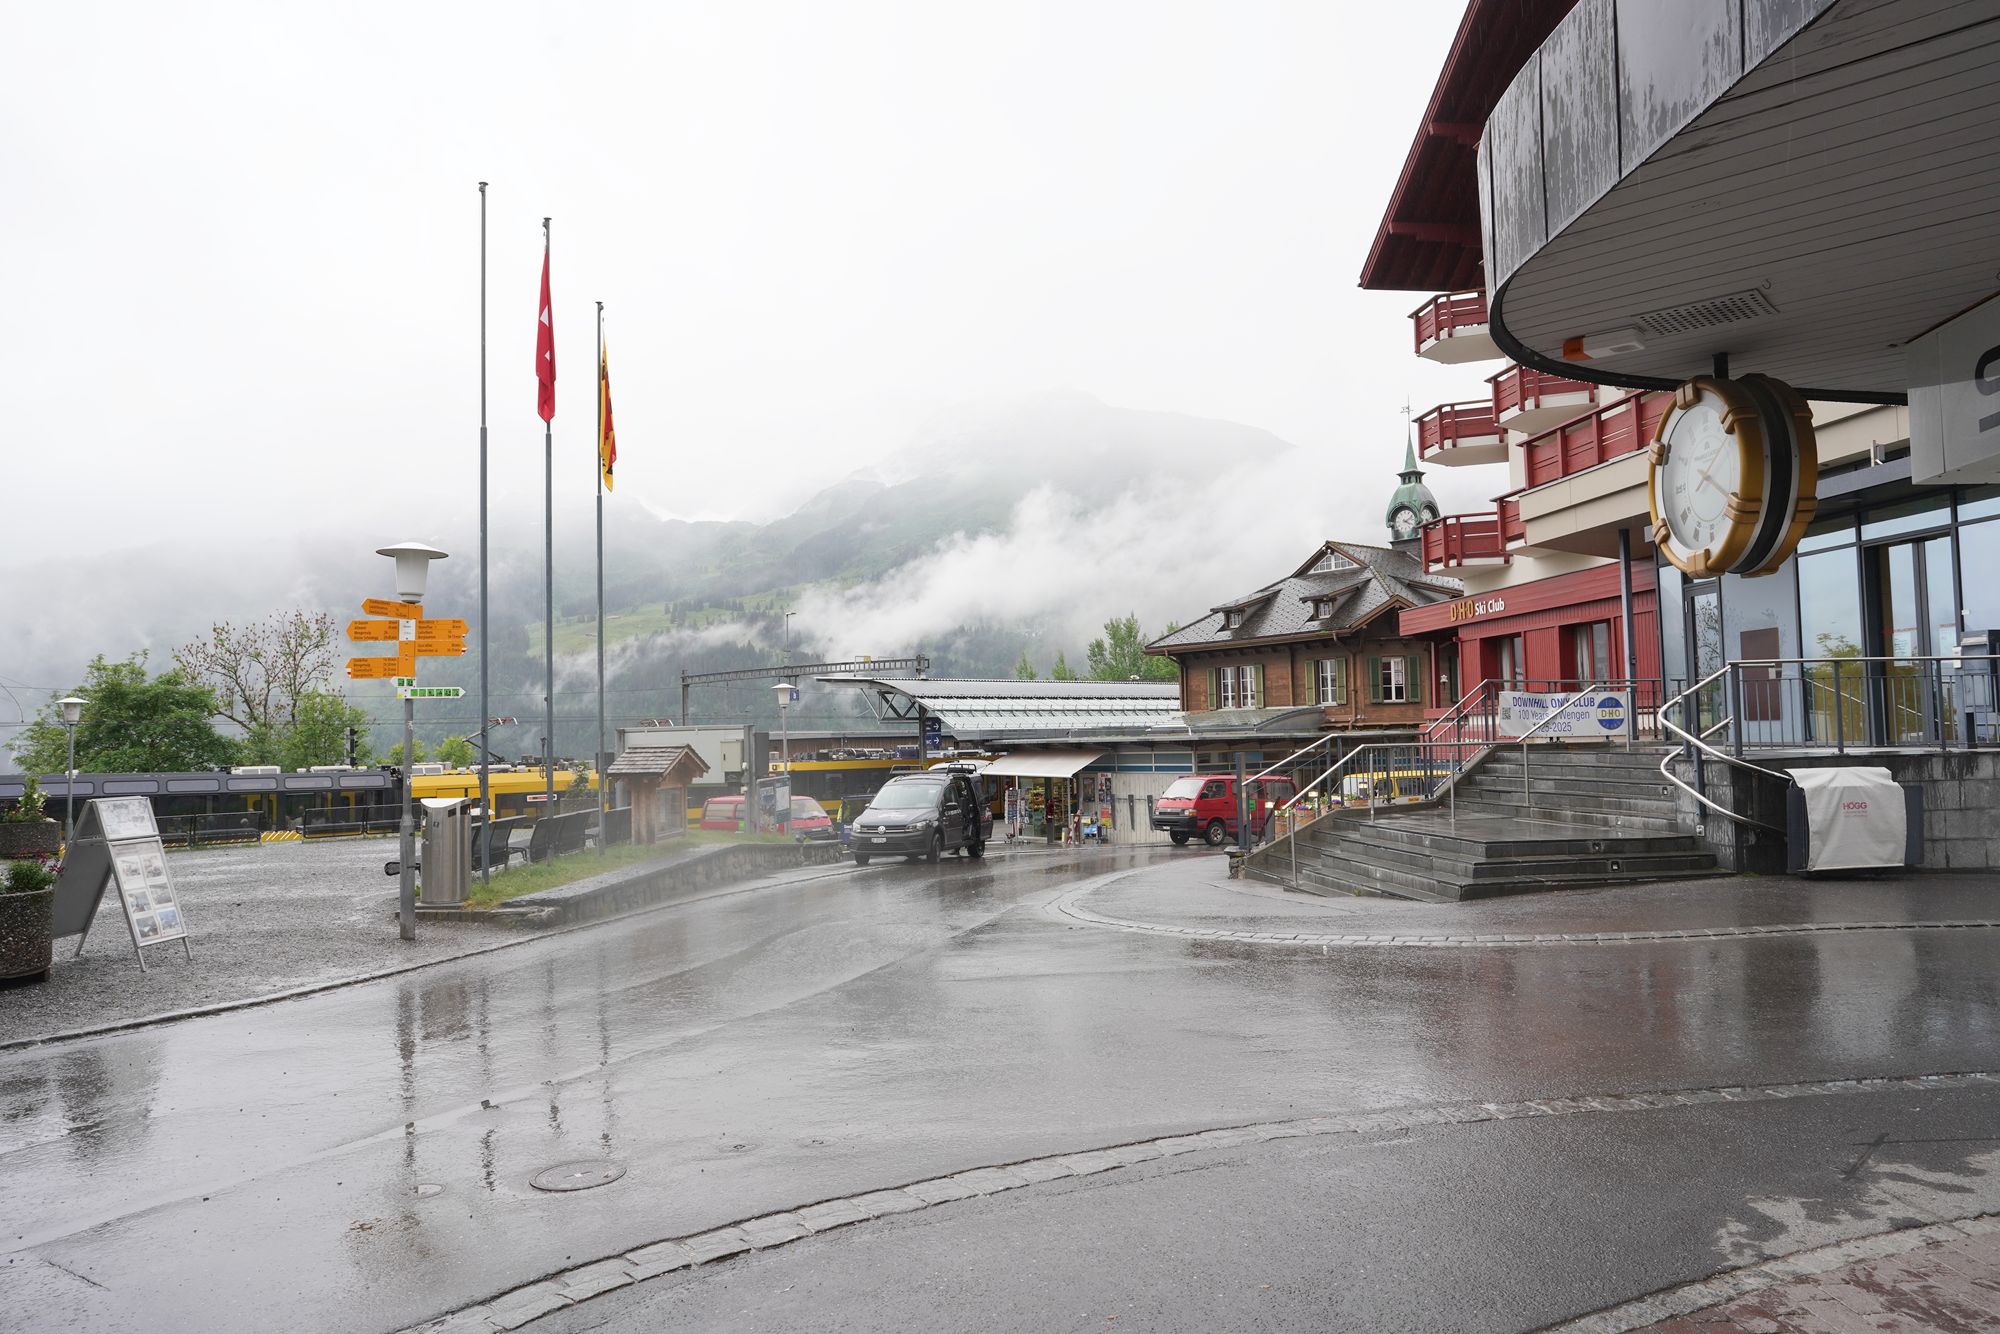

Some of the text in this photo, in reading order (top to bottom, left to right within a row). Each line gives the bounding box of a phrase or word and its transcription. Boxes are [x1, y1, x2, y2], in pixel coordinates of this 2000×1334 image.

[1475, 601, 1486, 616] Ski
[1487, 597, 1505, 613] Club
[1512, 696, 1549, 709] DOWNHILL
[1573, 696, 1595, 708] CLUB
[1518, 709, 1530, 720] 100
[1531, 709, 1550, 720] Years
[1558, 709, 1590, 721] Wengen
[1533, 721, 1573, 733] 25-2025
